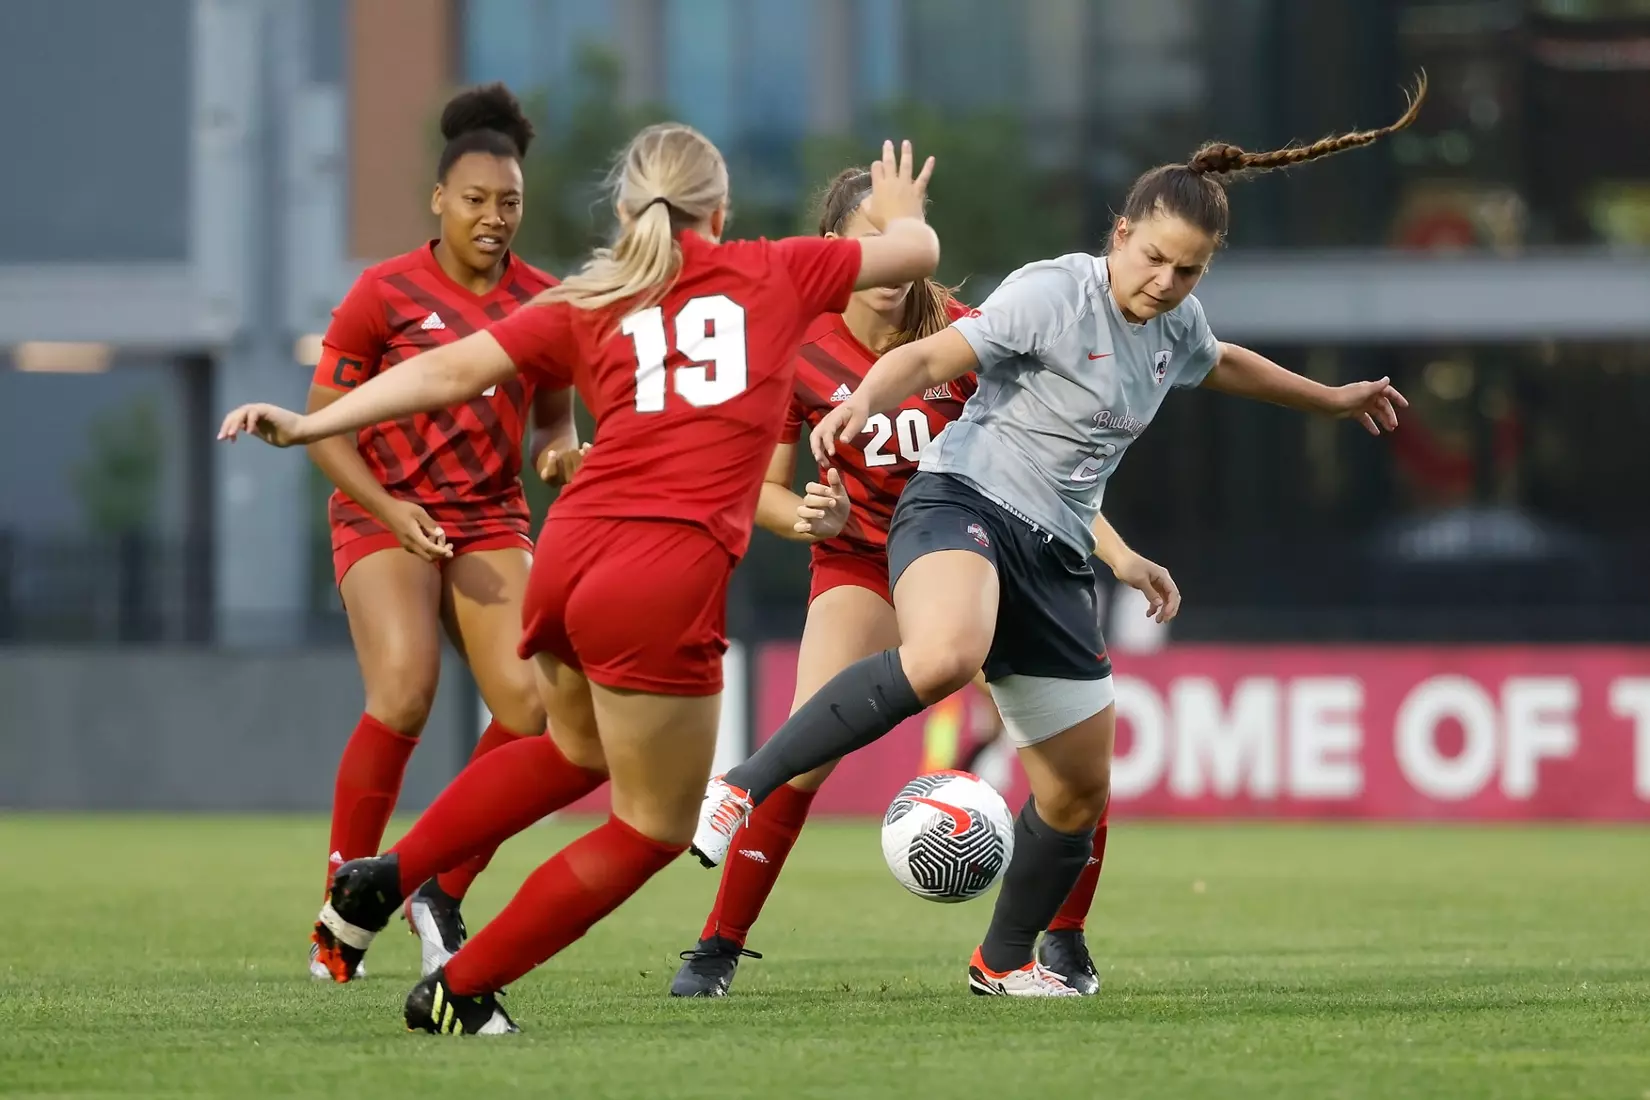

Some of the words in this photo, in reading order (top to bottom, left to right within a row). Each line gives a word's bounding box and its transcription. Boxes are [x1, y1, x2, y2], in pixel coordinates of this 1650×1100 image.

[332, 356, 364, 388] C
[620, 294, 748, 413] 19
[861, 408, 932, 468] 20
[1069, 443, 1117, 484] 2
[1112, 674, 1365, 800] OME
[1393, 674, 1580, 800] OF
